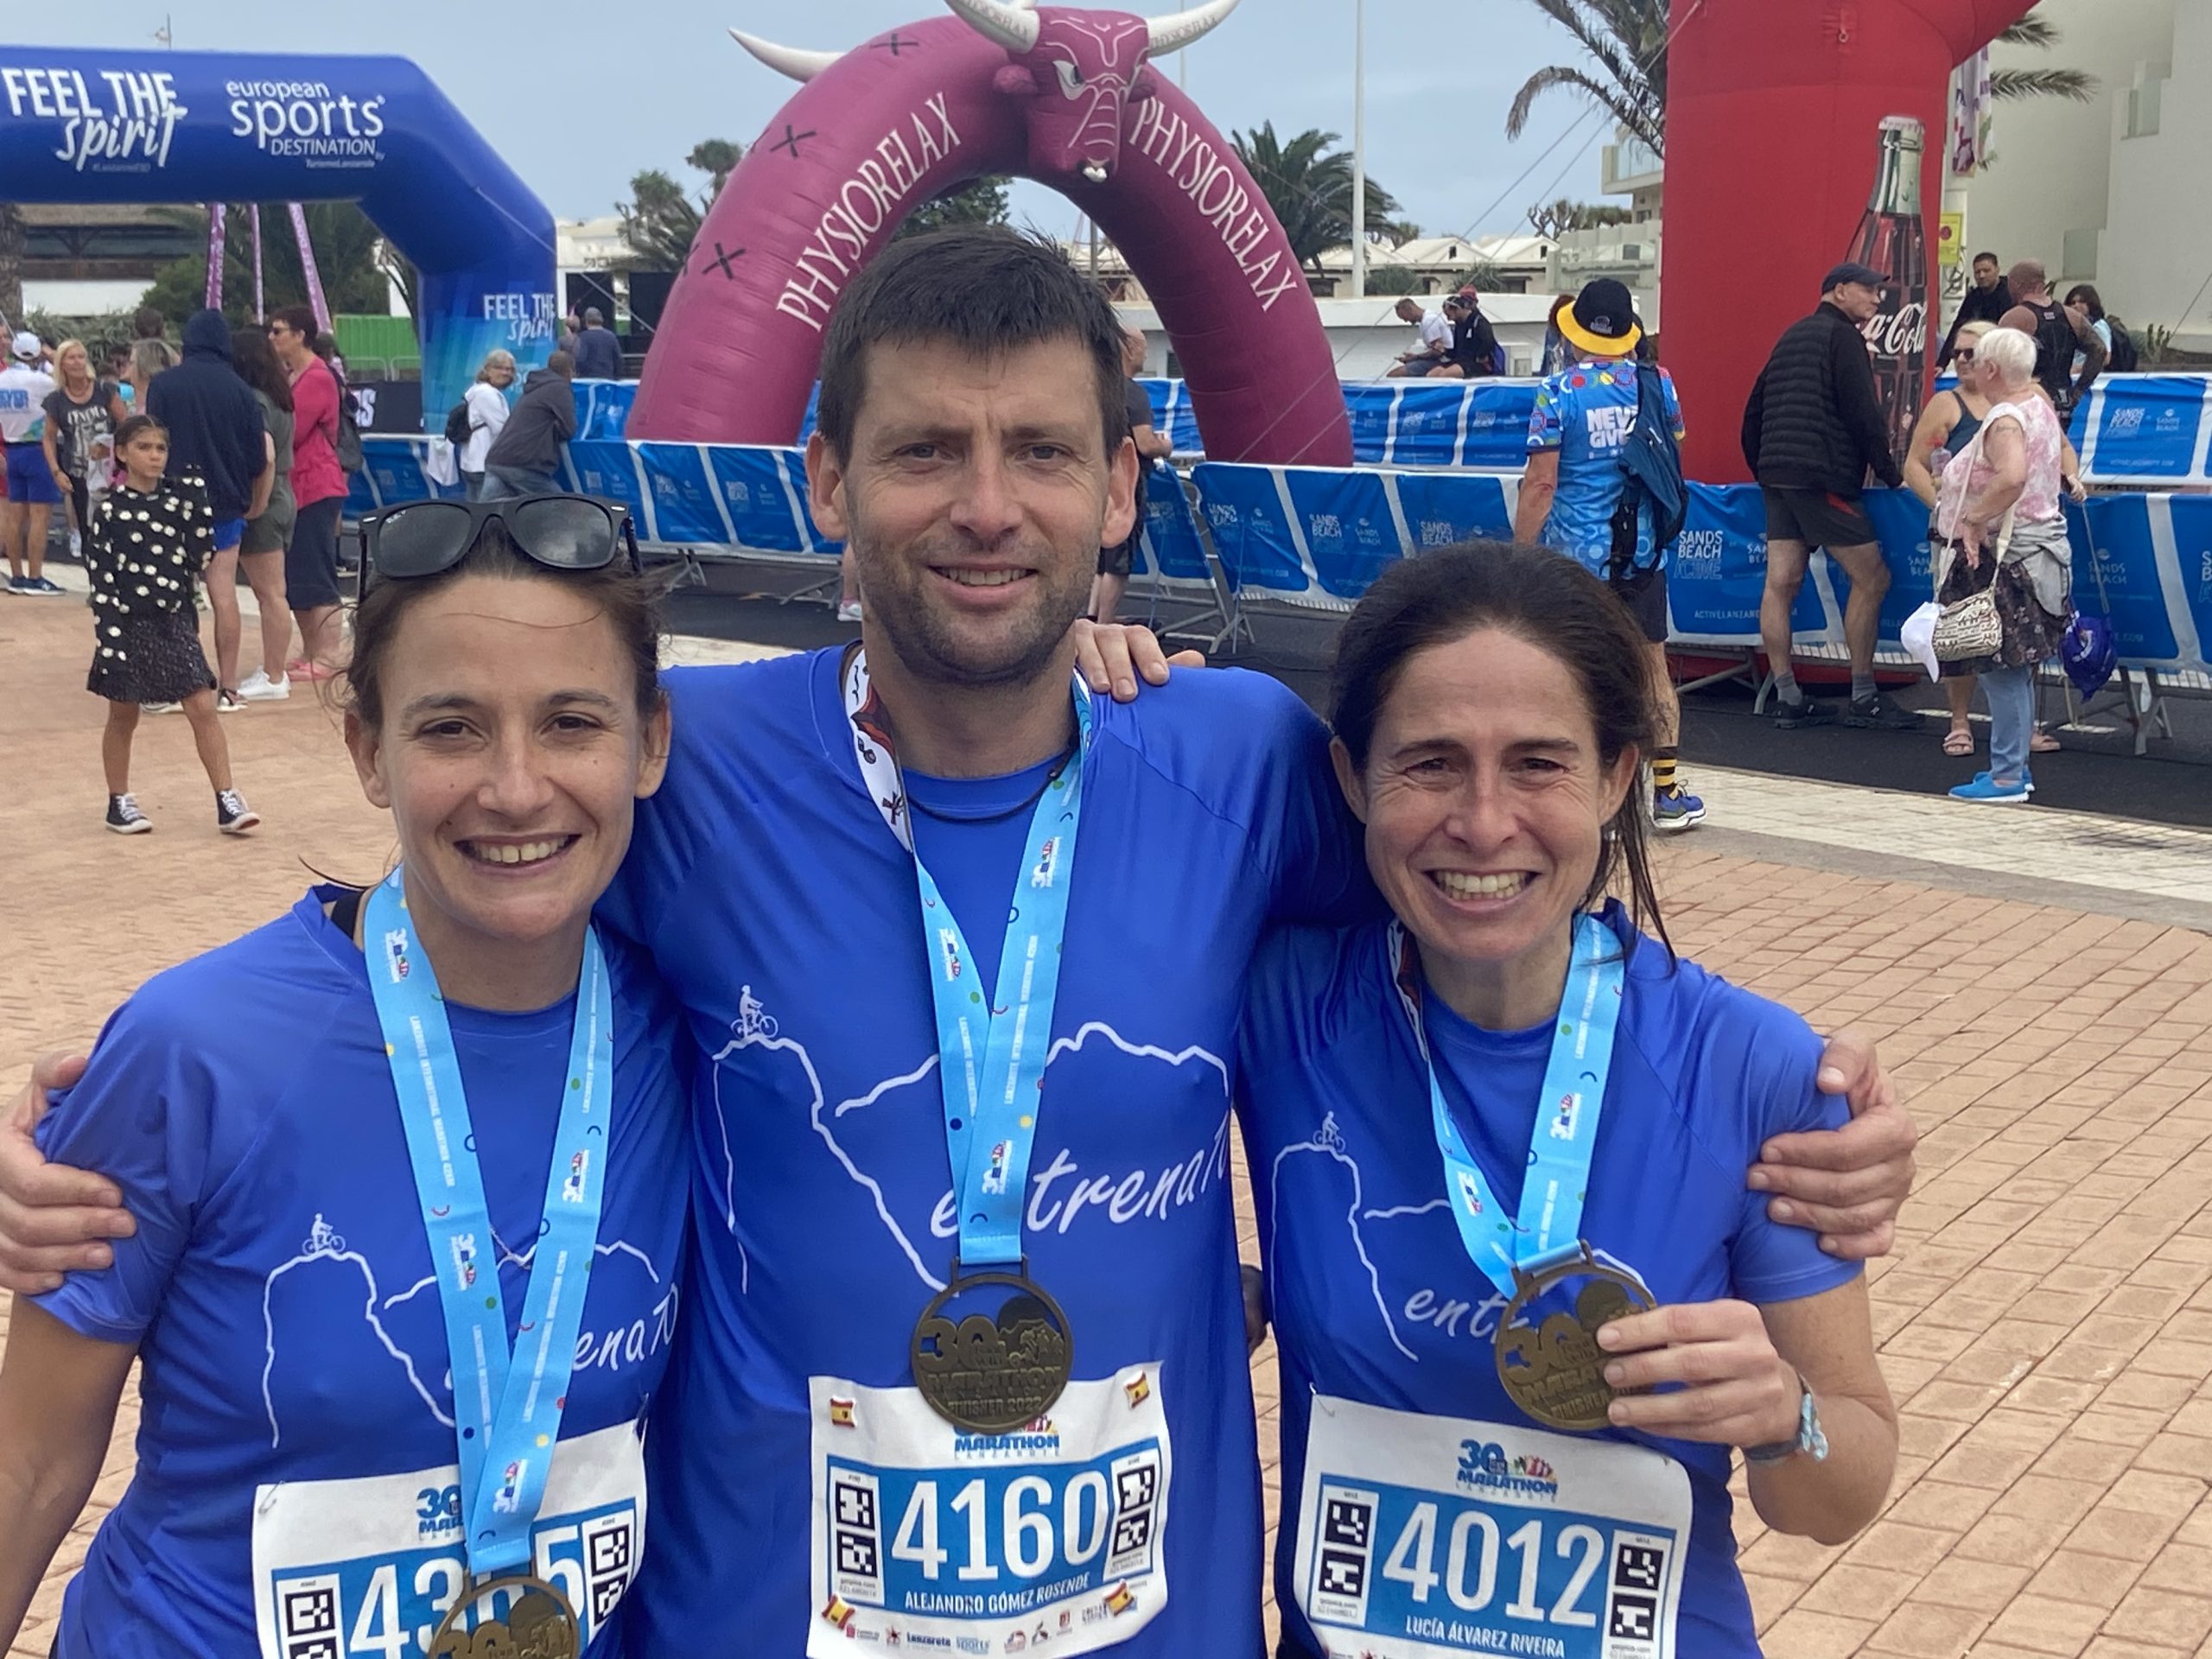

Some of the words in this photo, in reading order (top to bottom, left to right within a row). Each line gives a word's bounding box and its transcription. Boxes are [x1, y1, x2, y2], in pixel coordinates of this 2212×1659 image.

[2, 68, 103, 117] FEEL
[99, 71, 177, 118] THE
[226, 80, 330, 102] european
[55, 101, 188, 172] spirit
[230, 95, 385, 149] sports
[270, 137, 376, 156] DESTINATION
[776, 91, 961, 334] PHYSIORELAX
[1128, 96, 1298, 313] PHYSIORELAX
[484, 294, 530, 320] FEEL
[531, 293, 556, 319] THE
[506, 315, 555, 347] spirit
[1586, 405, 1639, 433] NEV
[1311, 524, 1342, 538] BEACH
[1420, 520, 1453, 535] SANDS
[1421, 532, 1453, 546] BEACH
[1678, 530, 1724, 545] SANDS
[1677, 544, 1723, 559] BEACH
[1748, 554, 1768, 563] BEA
[1404, 1288, 1510, 1338] ent
[955, 1435, 1059, 1452] MARATHON
[1457, 1439, 1506, 1473] 30
[1457, 1467, 1559, 1494] MARATHON
[891, 1471, 1110, 1581] 4160
[1382, 1501, 1605, 1628] 4012
[905, 1590, 984, 1615] ALEJANDRO
[988, 1587, 1035, 1614] GÓMEZ
[1037, 1571, 1091, 1604] ROSENDE
[1405, 1614, 1446, 1640] LUCÍA
[1447, 1620, 1508, 1650] ÁLVAREZ
[1510, 1631, 1566, 1659] RIVEIRA
